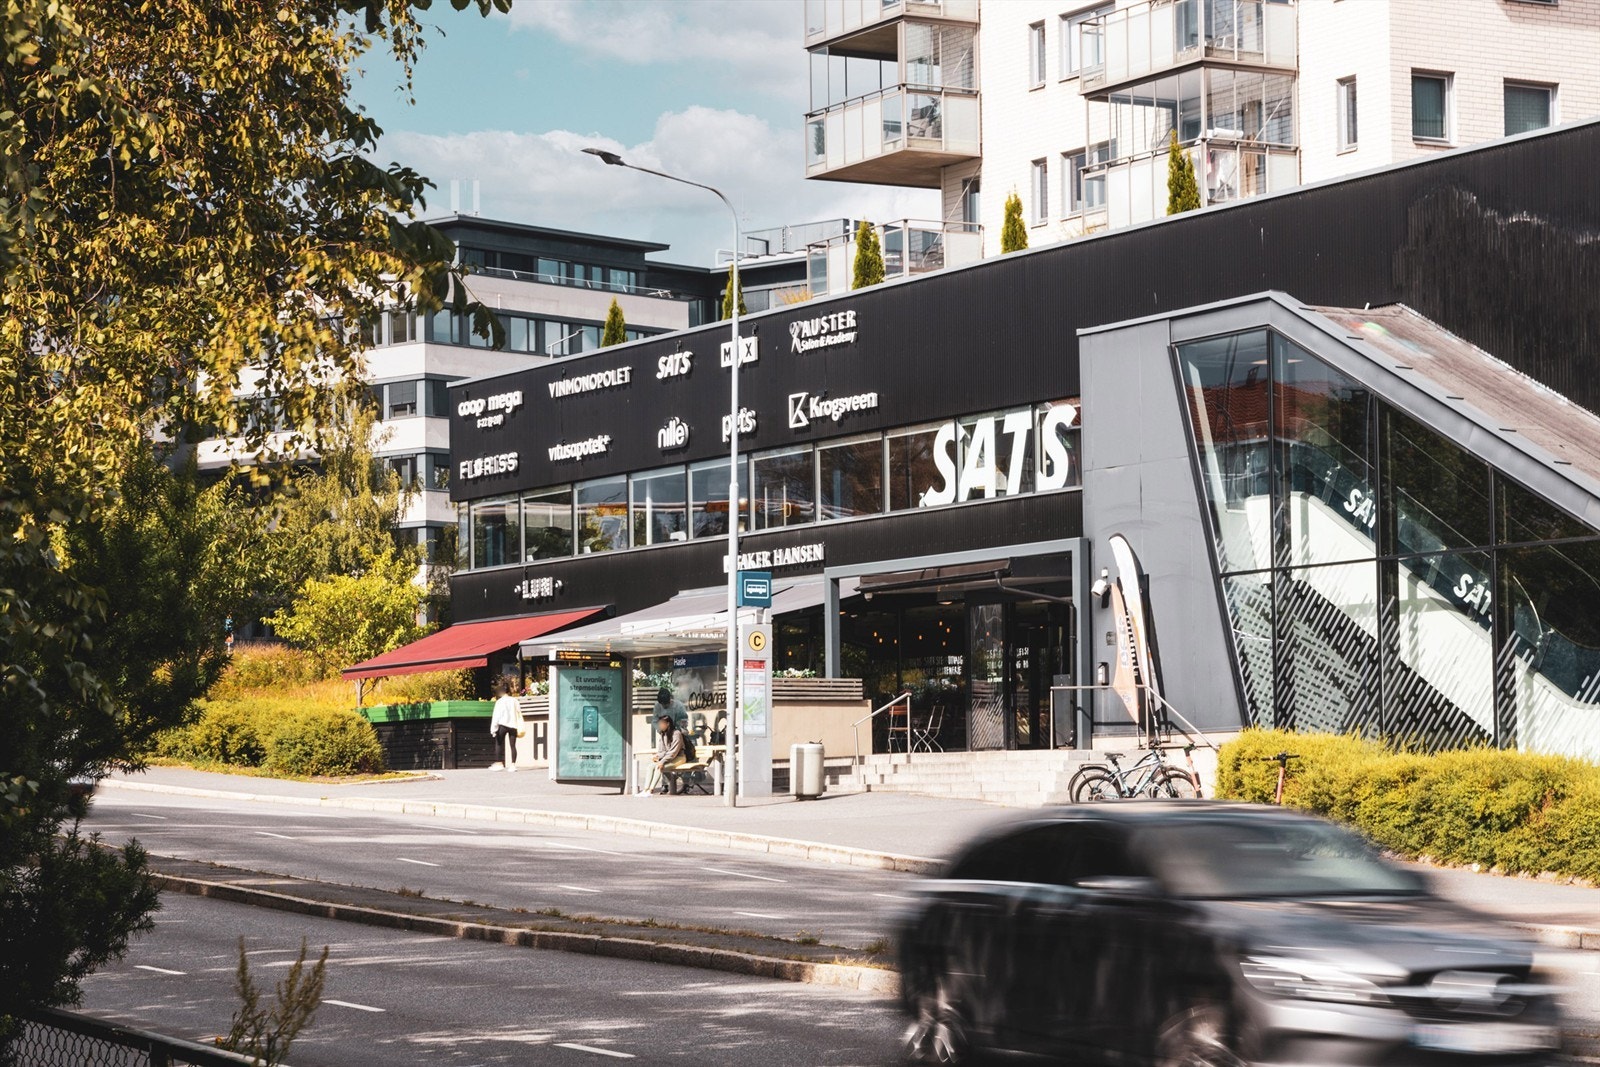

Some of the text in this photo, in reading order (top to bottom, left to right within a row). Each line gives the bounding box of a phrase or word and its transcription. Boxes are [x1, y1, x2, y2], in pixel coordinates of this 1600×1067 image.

[801, 310, 856, 338] AUSTER
[801, 338, 820, 352] Salon
[826, 331, 858, 348] Academy
[656, 351, 693, 379] SATS
[548, 366, 632, 398] VINMONOPOLET
[458, 390, 523, 417] coop mega
[809, 392, 878, 422] Krogsveen
[722, 408, 757, 442] pts
[921, 404, 1077, 508] SATS
[773, 543, 825, 567] HANSEN
[754, 635, 761, 647] C
[673, 657, 687, 667] Hasle
[575, 675, 606, 685] Et uvanlig
